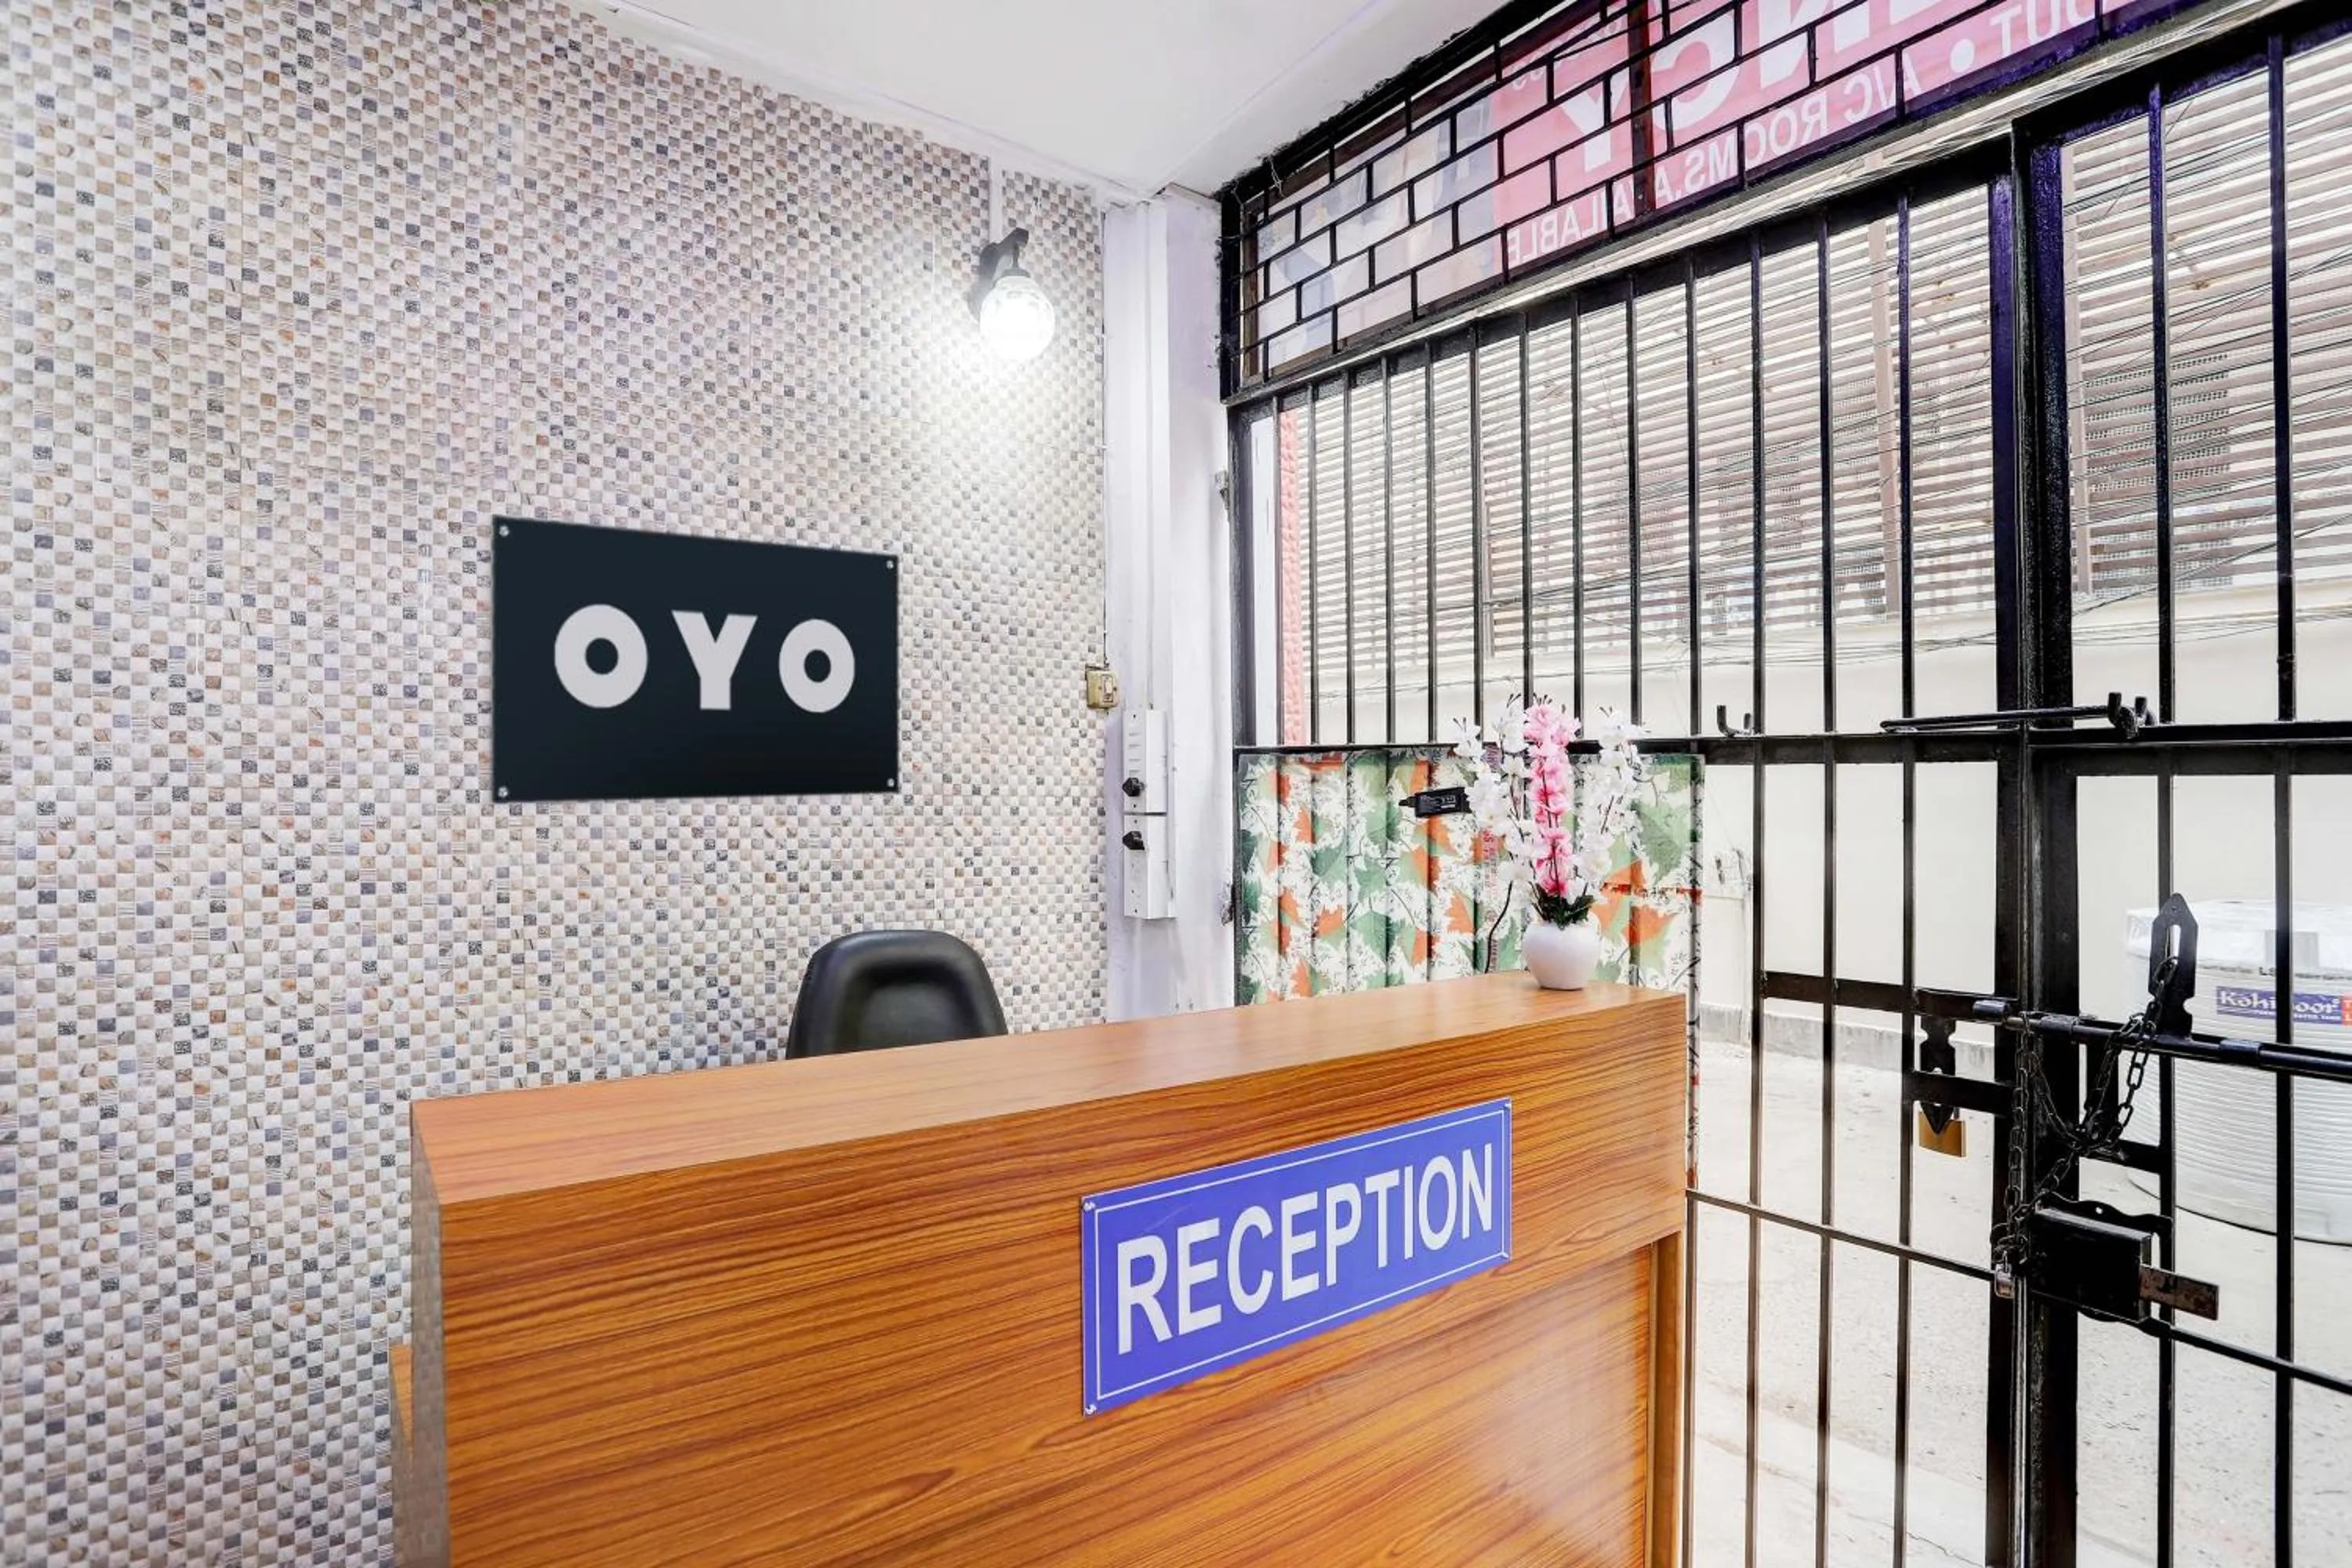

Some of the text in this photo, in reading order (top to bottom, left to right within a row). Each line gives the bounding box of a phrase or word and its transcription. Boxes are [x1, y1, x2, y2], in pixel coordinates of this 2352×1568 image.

[554, 604, 855, 713] OYO
[2220, 990, 2335, 1014] Kohioor
[1117, 1143, 1493, 1355] RECEPTION
